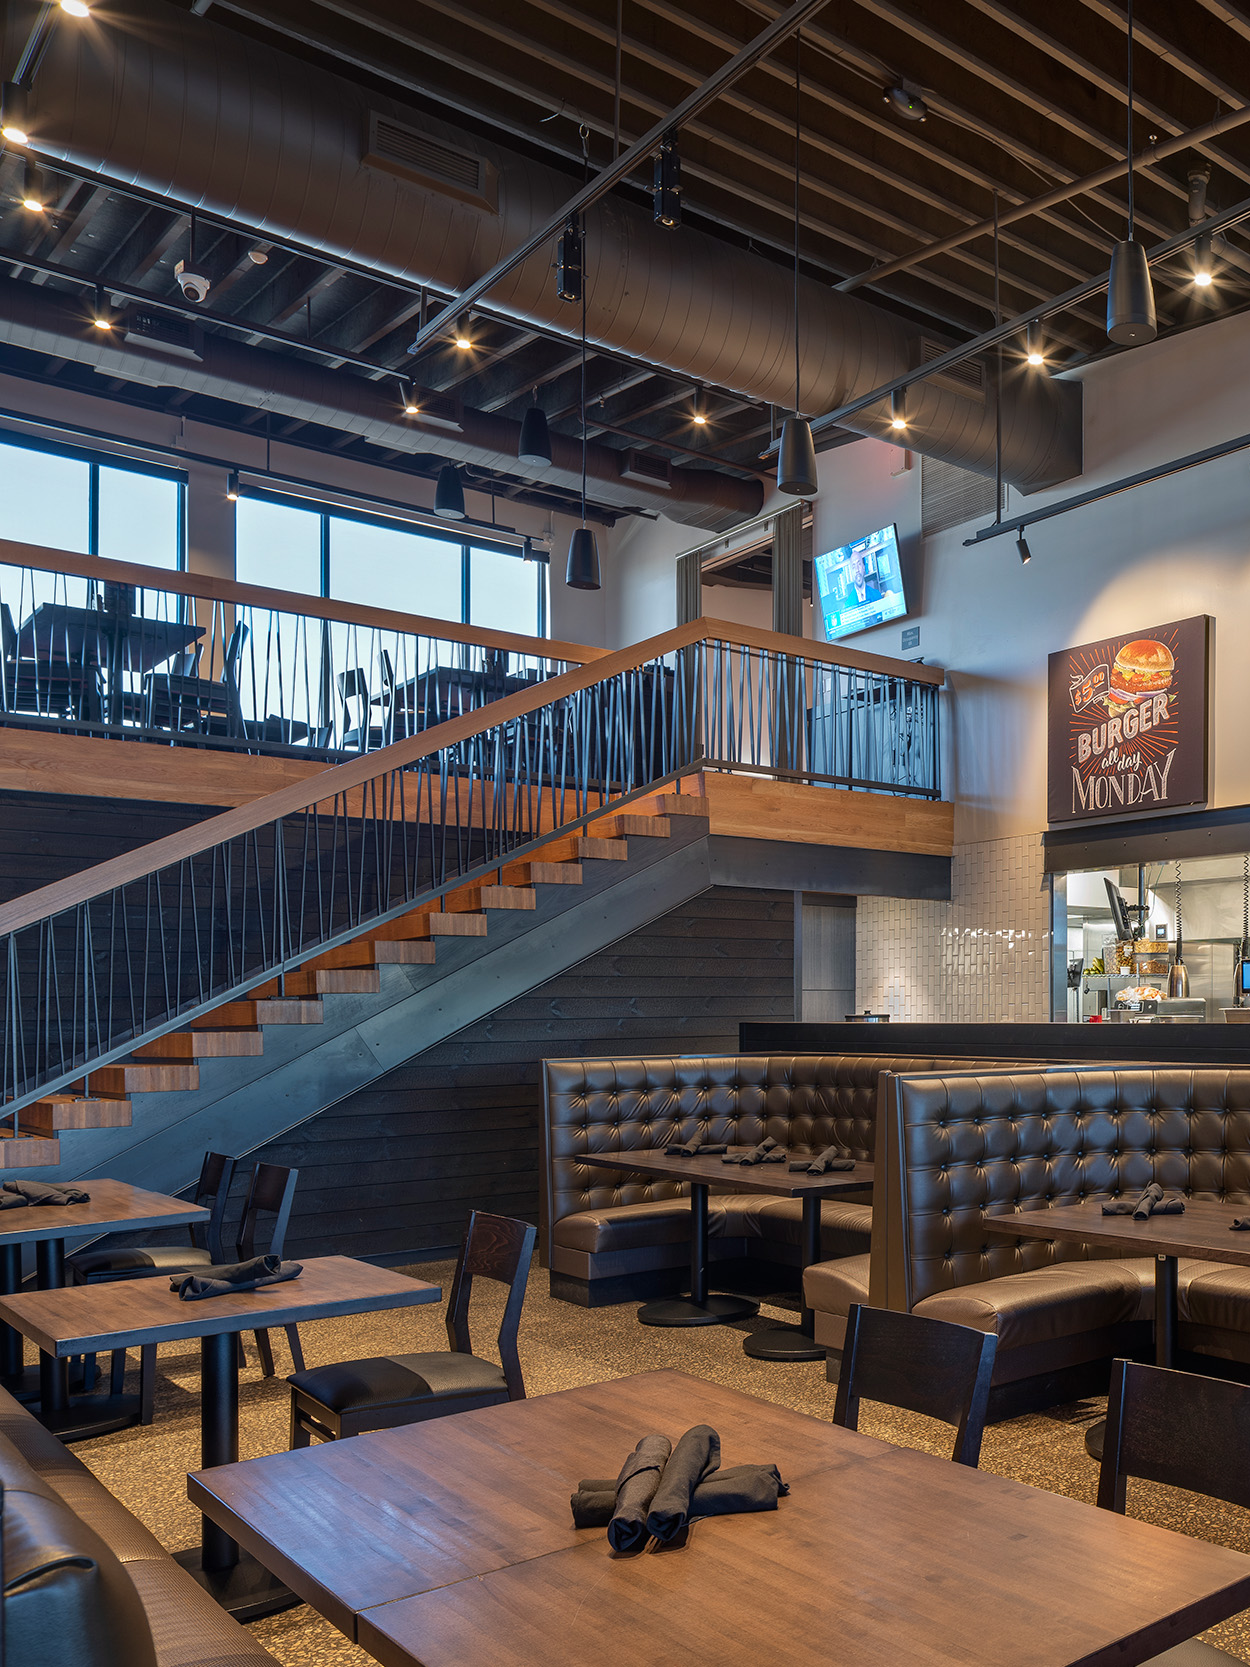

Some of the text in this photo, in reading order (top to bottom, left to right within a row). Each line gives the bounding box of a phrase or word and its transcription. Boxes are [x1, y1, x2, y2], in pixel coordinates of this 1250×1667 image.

[1077, 692, 1170, 764] BURGER
[1101, 747, 1142, 771] all day
[1071, 747, 1177, 814] MONDAY
